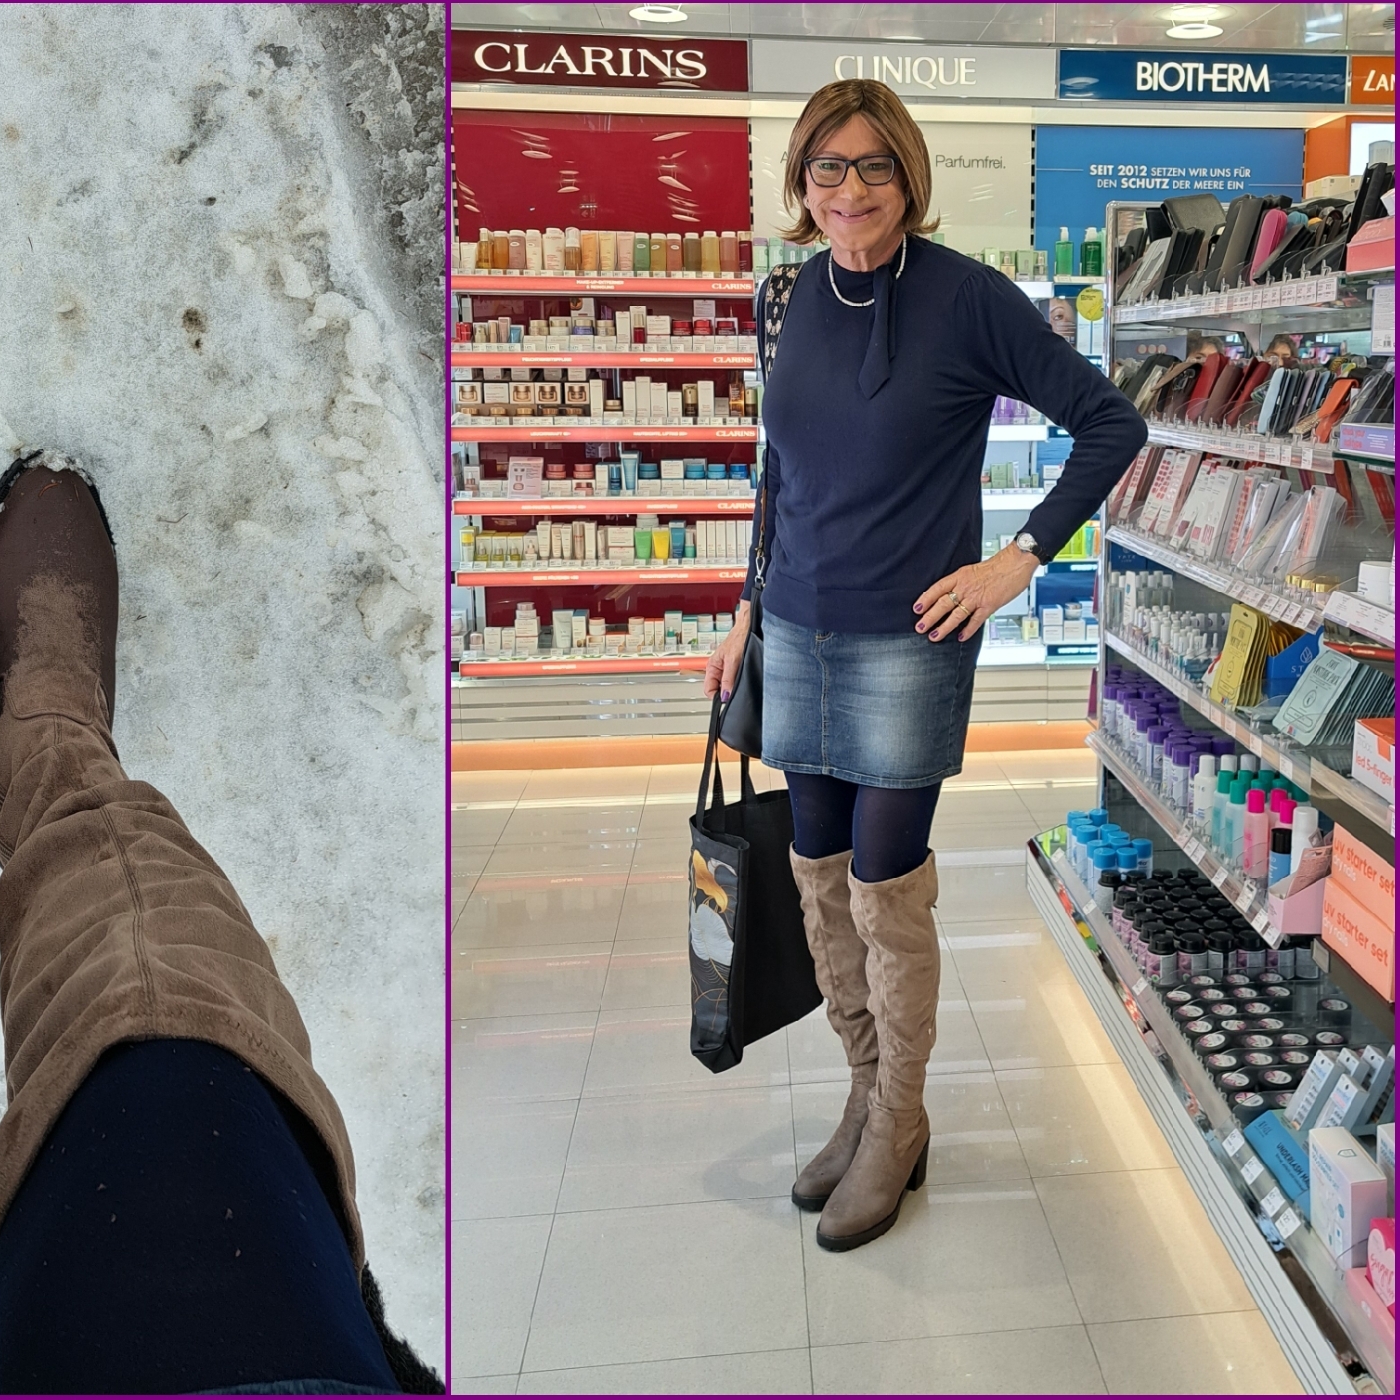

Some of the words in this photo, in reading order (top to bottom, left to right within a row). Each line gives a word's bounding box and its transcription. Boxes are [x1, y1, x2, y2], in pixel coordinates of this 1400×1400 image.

[474, 41, 707, 79] CLARINS
[834, 55, 976, 89] CLINIQUE
[1136, 61, 1271, 92] BIOTHERM
[935, 154, 1006, 169] Parfumfrei.
[1089, 164, 1114, 176] SEIT
[1117, 165, 1148, 177] 2012
[1150, 167, 1186, 177] SETZEN
[1188, 168, 1208, 177] WIR
[1210, 168, 1231, 178] UNS
[1233, 167, 1251, 178] FÜR
[1097, 178, 1117, 188] DEN
[1120, 178, 1170, 189] SCHUTZ
[1172, 180, 1191, 190] DER
[1193, 180, 1224, 190] MEERE
[1227, 180, 1244, 190] EIN
[1333, 838, 1345, 855] uv
[1346, 847, 1377, 882] starter
[1379, 875, 1395, 898] set
[1324, 899, 1335, 918] uv
[1337, 912, 1369, 950] starter
[1370, 943, 1388, 968] set
